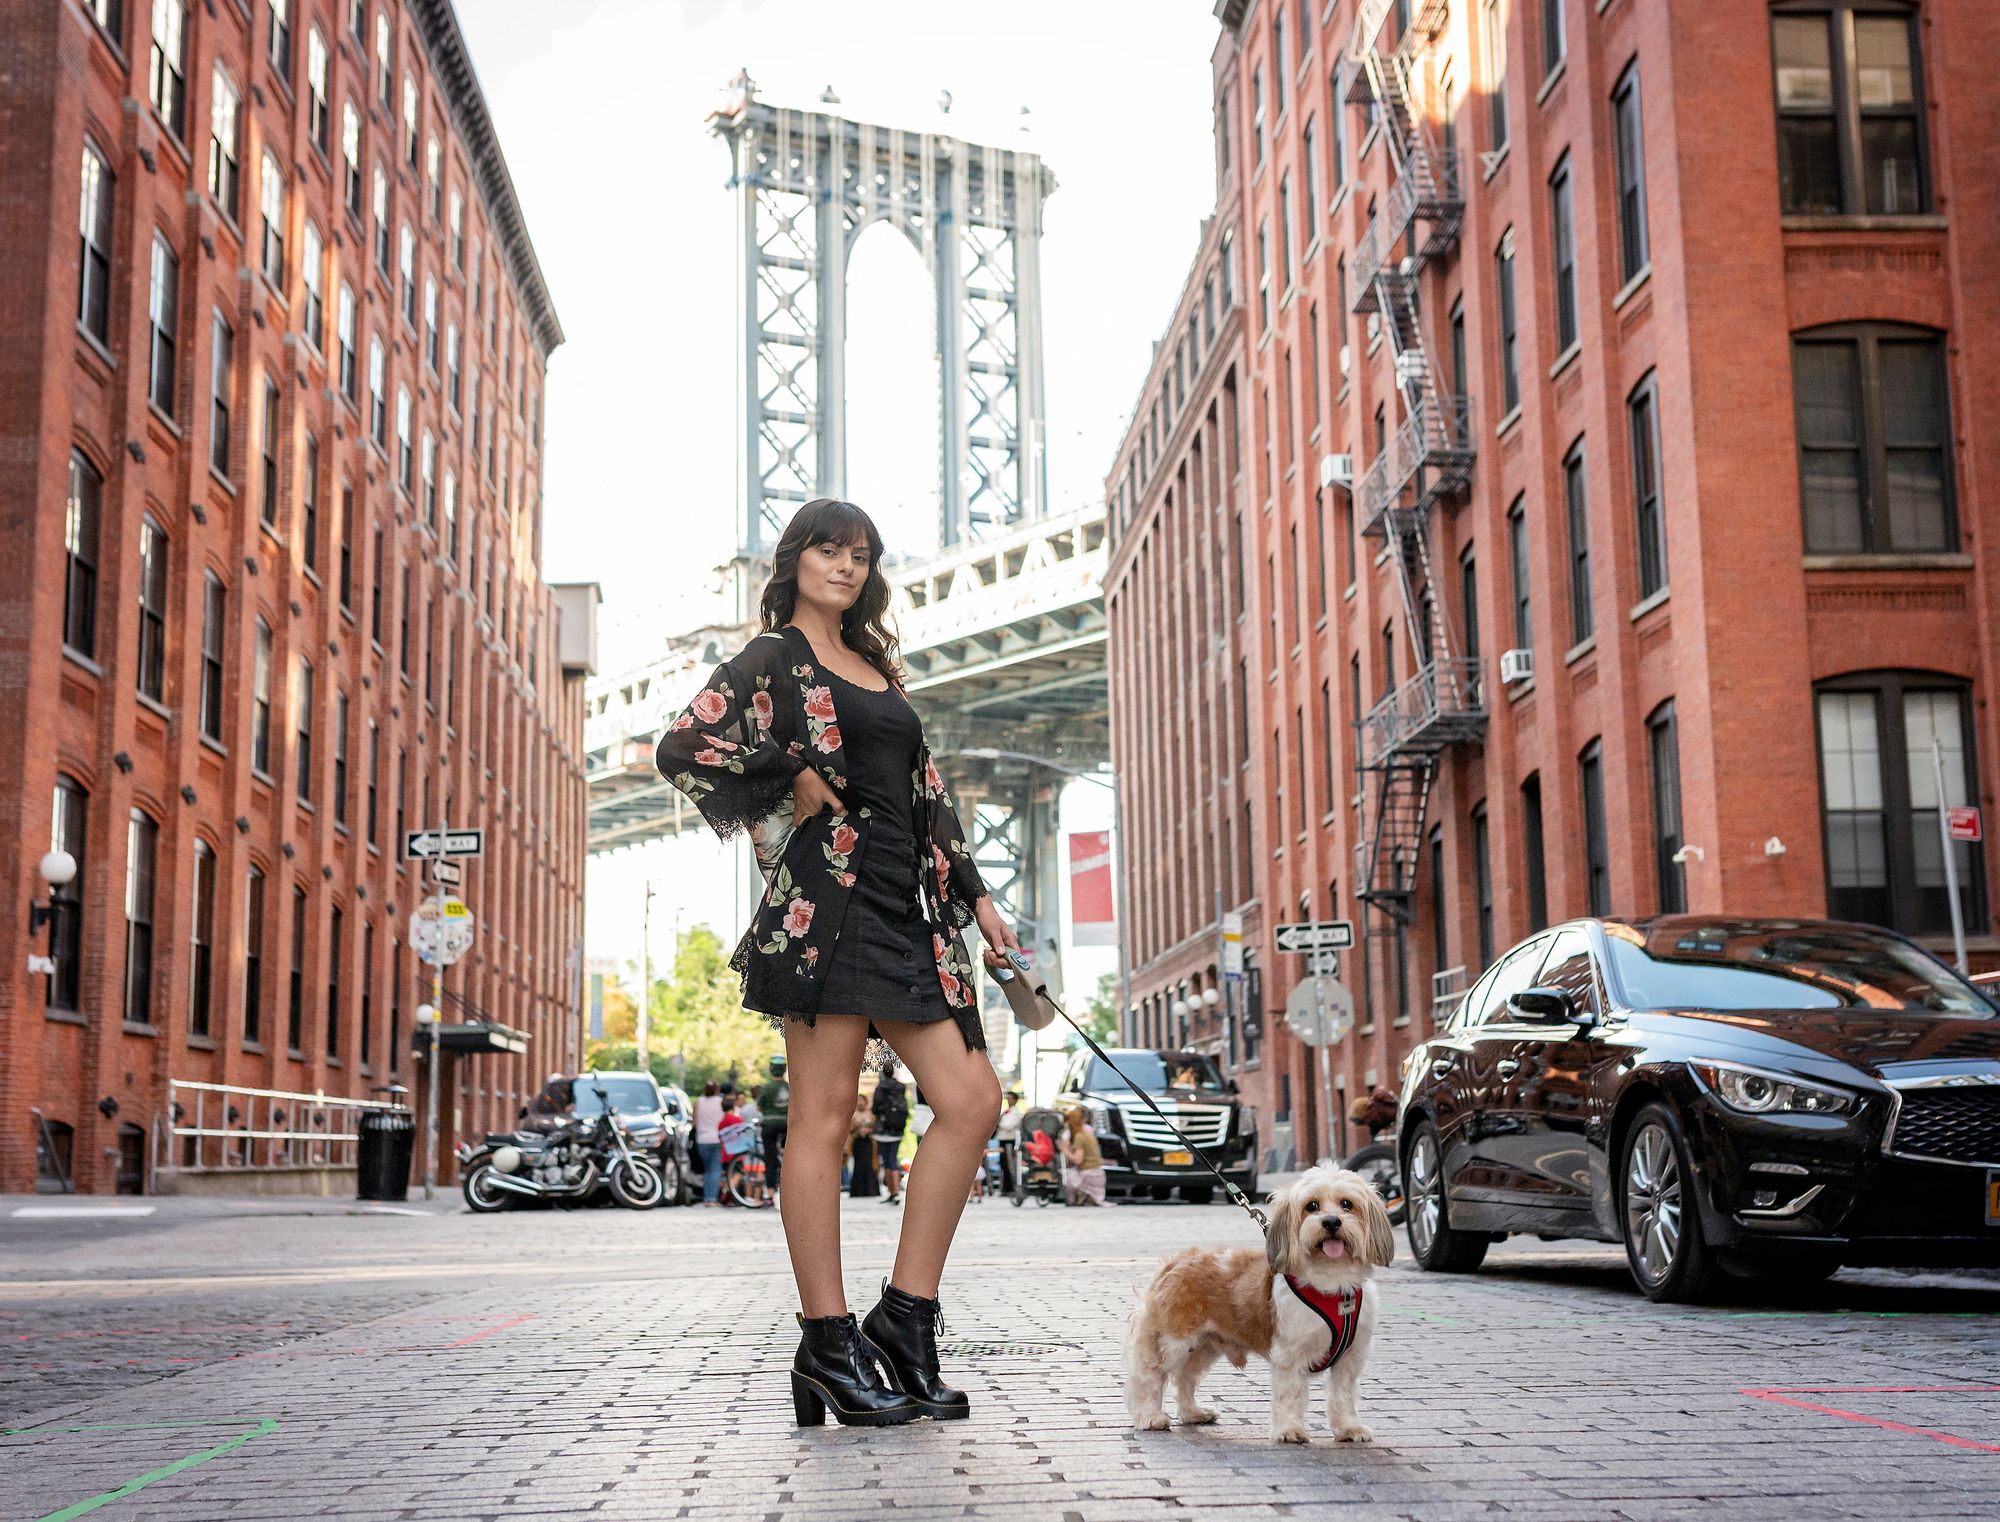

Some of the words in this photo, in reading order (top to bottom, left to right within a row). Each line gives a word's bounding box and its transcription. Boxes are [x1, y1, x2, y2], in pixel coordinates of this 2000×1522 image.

[419, 840, 440, 850] ONE
[450, 839, 472, 848] WAY
[1322, 931, 1345, 940] WAY
